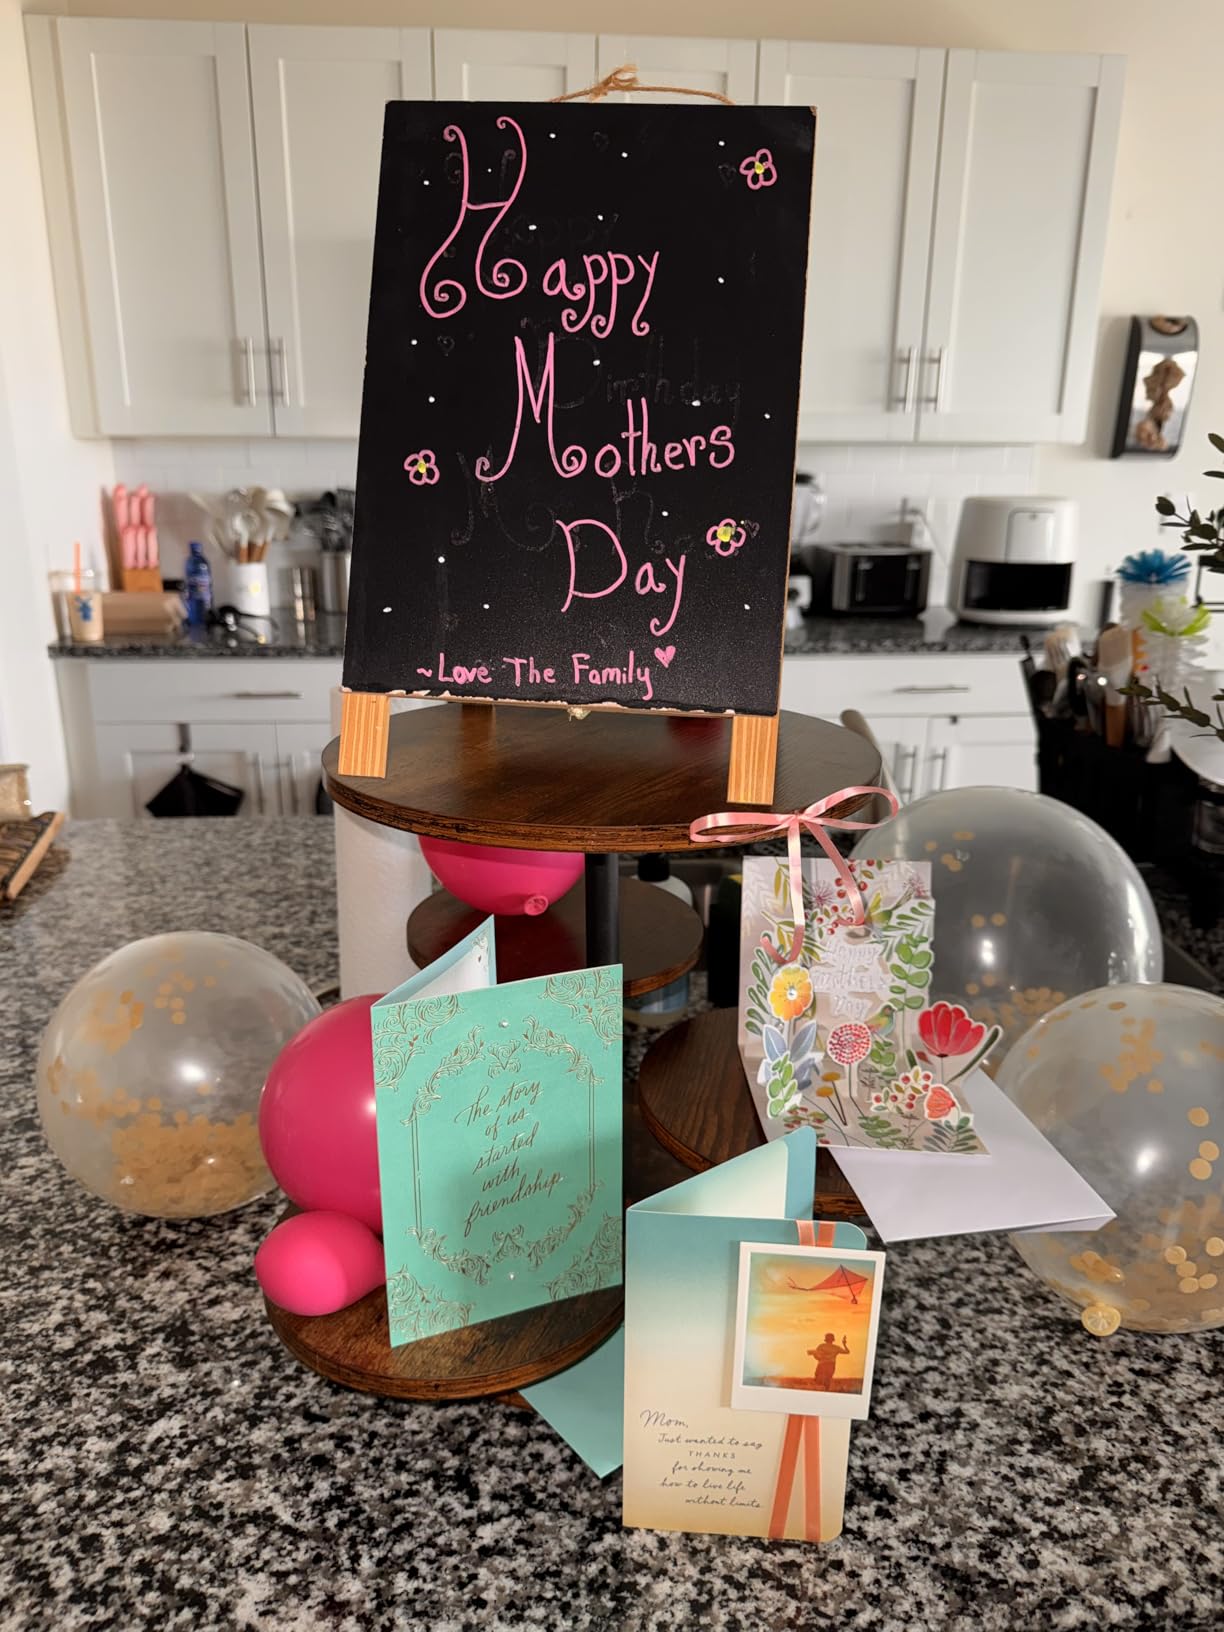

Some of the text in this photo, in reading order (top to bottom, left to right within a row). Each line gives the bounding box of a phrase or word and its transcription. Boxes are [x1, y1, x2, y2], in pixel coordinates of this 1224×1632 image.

[420, 116, 660, 338] Happy
[475, 332, 735, 481] Mothers
[555, 518, 686, 637] Day
[503, 656, 556, 687] The
[571, 650, 655, 701] Family
[454, 1079, 544, 1127] The story
[485, 1107, 527, 1141] of us
[472, 1121, 540, 1175] started
[482, 1157, 520, 1192] with
[464, 1168, 562, 1238] friendship
[640, 1409, 689, 1429] Mom,
[658, 1432, 763, 1450] Just wanted to say
[688, 1450, 737, 1460] THANKS
[660, 1477, 746, 1494] how to live life
[672, 1461, 688, 1475] for
[691, 1461, 734, 1477] showing
[685, 1495, 761, 1509] without limits
